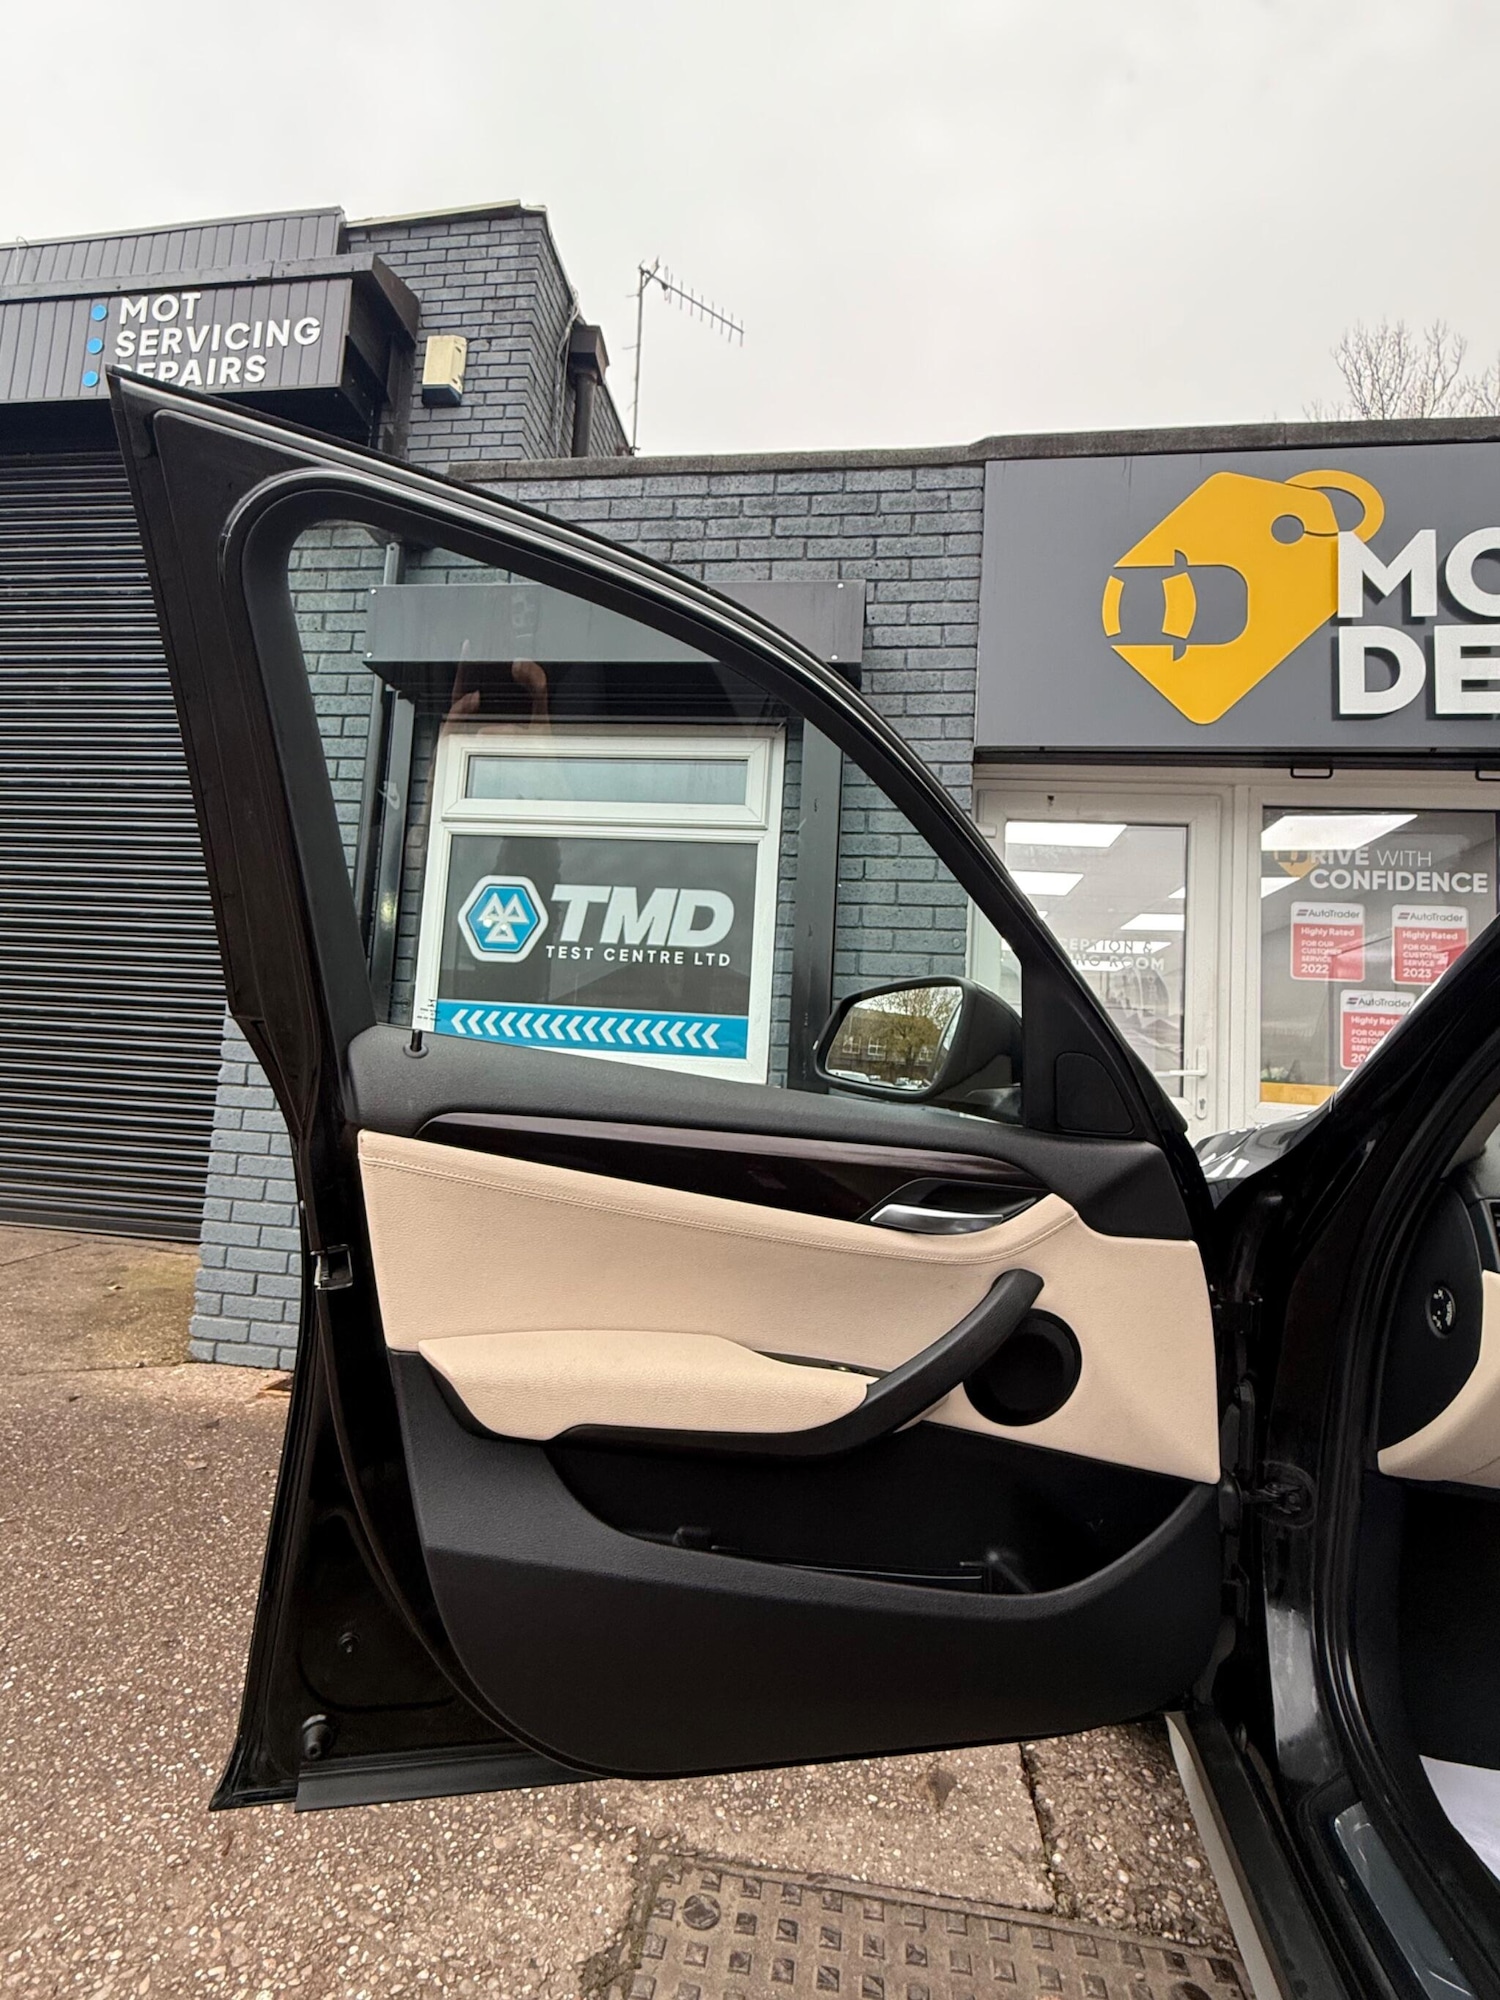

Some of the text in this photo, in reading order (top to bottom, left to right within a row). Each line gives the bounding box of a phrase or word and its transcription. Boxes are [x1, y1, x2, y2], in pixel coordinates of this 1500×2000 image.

[119, 292, 201, 325] MOT
[114, 316, 321, 357] SERVICING
[116, 354, 267, 387] EPAIRS
[1376, 850, 1432, 867] WITH
[1309, 868, 1489, 893] CONFIDENCE
[550, 884, 735, 948] TMD
[1308, 909, 1360, 918] AutoTrader
[1410, 912, 1464, 922] AutoTrader
[1300, 927, 1355, 937] Highly Rated
[1402, 931, 1458, 941] Highly Rated
[546, 945, 731, 967] TEST CENTRE LTD
[1109, 955, 1165, 971] ROOM
[1300, 963, 1329, 974] 2022
[1402, 968, 1432, 979] 2023
[1358, 997, 1411, 1007] AutoTrader
[1350, 1016, 1378, 1026] Highly
[1350, 1053, 1366, 1064] 20
